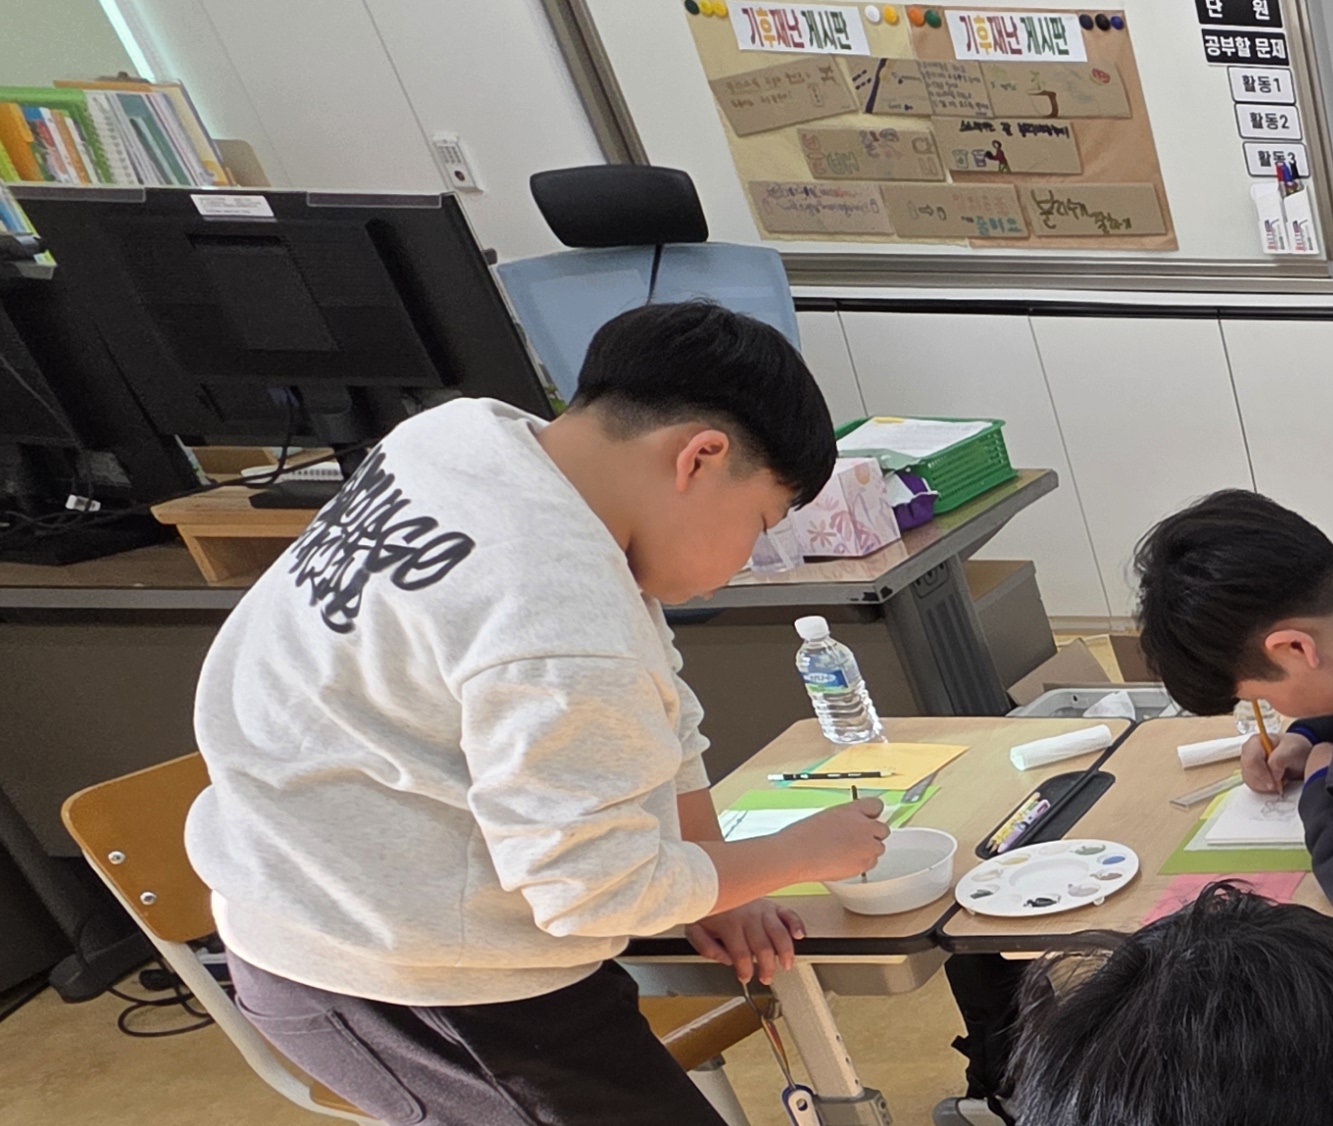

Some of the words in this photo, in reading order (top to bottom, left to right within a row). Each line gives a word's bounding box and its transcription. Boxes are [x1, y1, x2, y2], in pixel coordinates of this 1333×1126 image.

[742, 7, 805, 48] 기후재난
[801, 10, 852, 50] 게시판
[959, 14, 1023, 56] 기후재난
[1020, 16, 1070, 56] 게시판
[1204, 35, 1251, 58] 공부할
[1255, 38, 1287, 60] 문제
[1242, 75, 1283, 94] 활동1
[1249, 112, 1291, 130] 활동2
